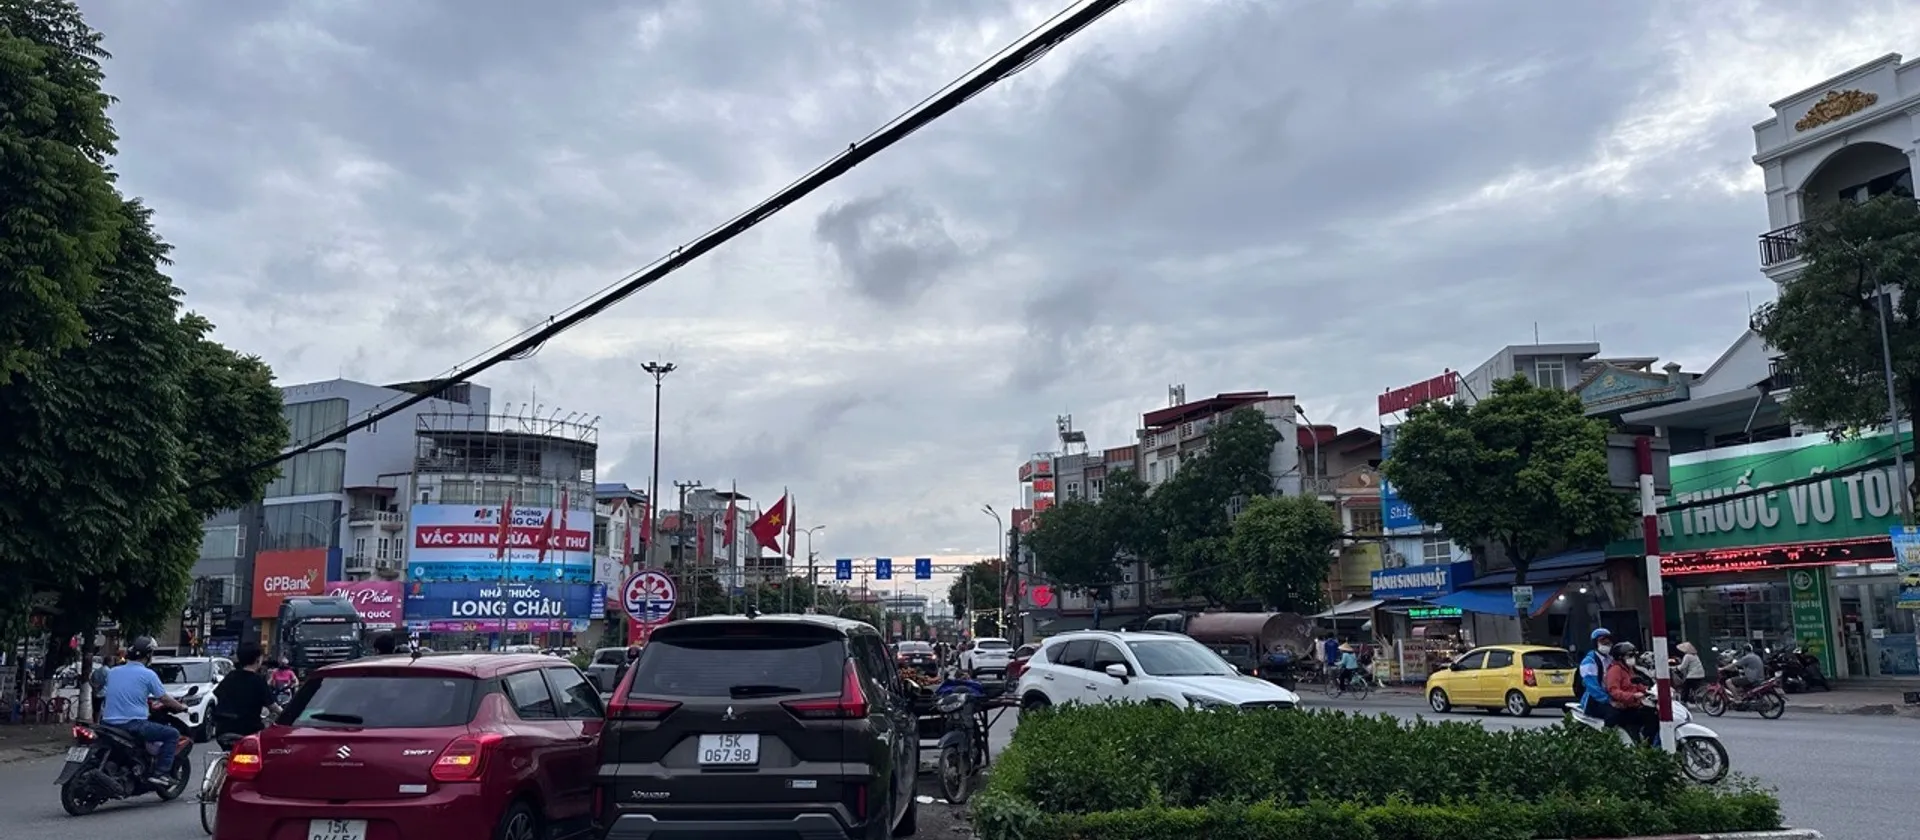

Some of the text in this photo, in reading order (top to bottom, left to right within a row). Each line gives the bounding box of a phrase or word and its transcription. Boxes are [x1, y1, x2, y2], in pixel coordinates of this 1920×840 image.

[1676, 468, 1780, 535] THUỐC
[1788, 465, 1836, 525] VŨ
[420, 528, 453, 544] VẮC
[457, 533, 485, 545] XIN
[263, 575, 311, 592] GPBank
[1398, 574, 1420, 589] SINH
[452, 600, 507, 617] LONG
[718, 735, 741, 748] 15K
[704, 749, 752, 762] 067.98
[327, 820, 350, 833] 15K
